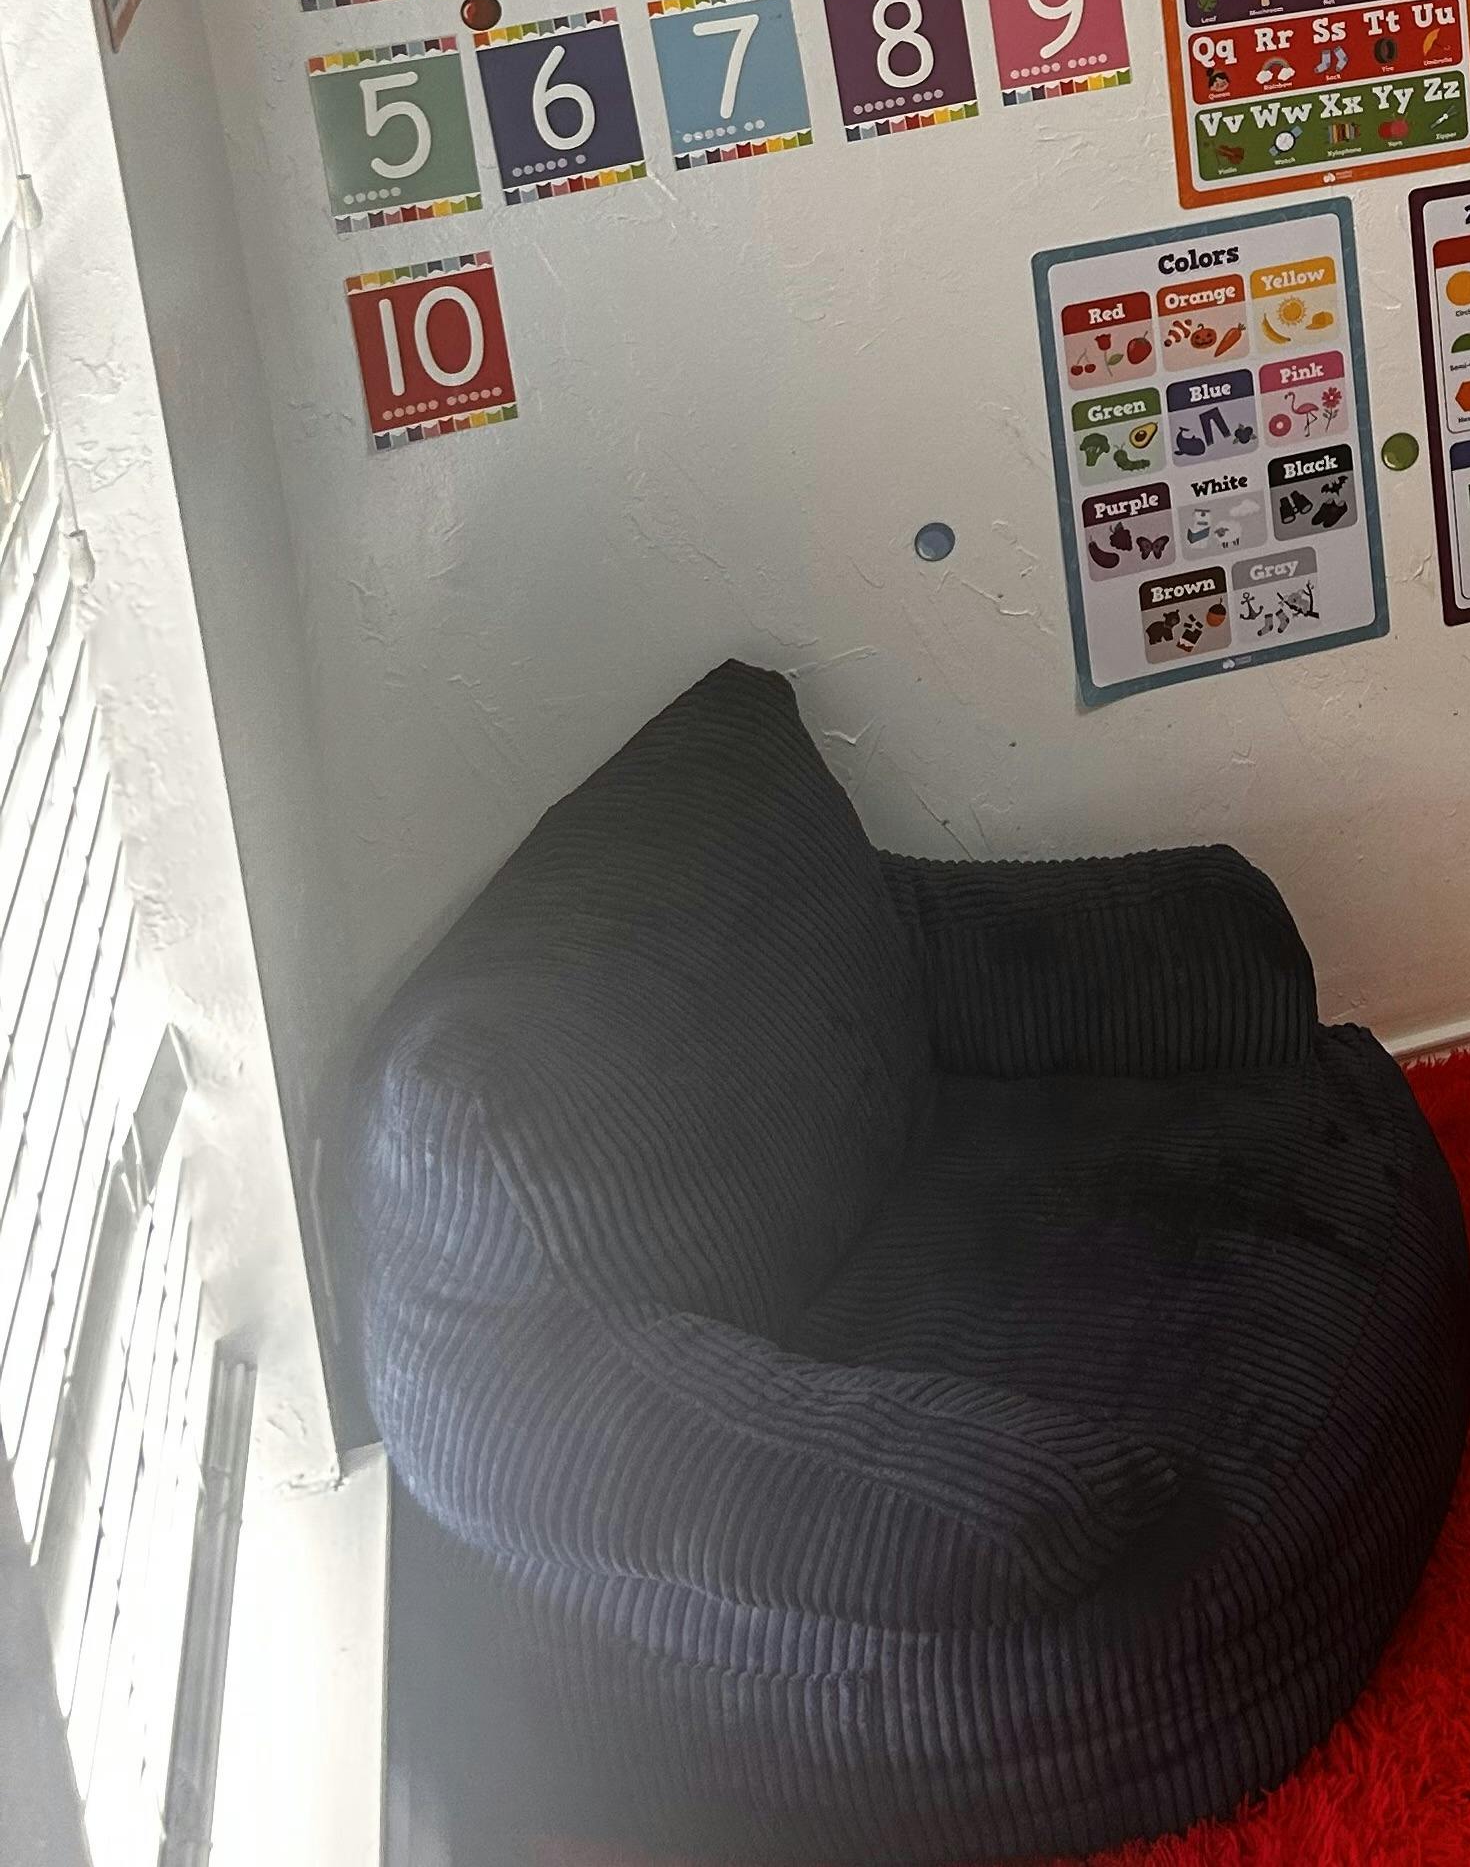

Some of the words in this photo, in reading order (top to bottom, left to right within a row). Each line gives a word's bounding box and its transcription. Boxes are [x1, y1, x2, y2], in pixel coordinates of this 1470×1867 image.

[532, 45, 596, 151] 6
[693, 15, 759, 119] 7
[358, 71, 431, 180] 5
[1087, 303, 1125, 324] Red
[1164, 284, 1236, 310] Orange
[1260, 266, 1325, 290] Yellow
[1157, 244, 1240, 276] Colors
[378, 285, 486, 396] 10
[1087, 398, 1147, 422] Green
[1189, 380, 1232, 400] Blue
[1279, 363, 1324, 384] Pink
[1094, 493, 1159, 519] Purple
[1191, 474, 1248, 497] White
[1282, 454, 1338, 479] Black
